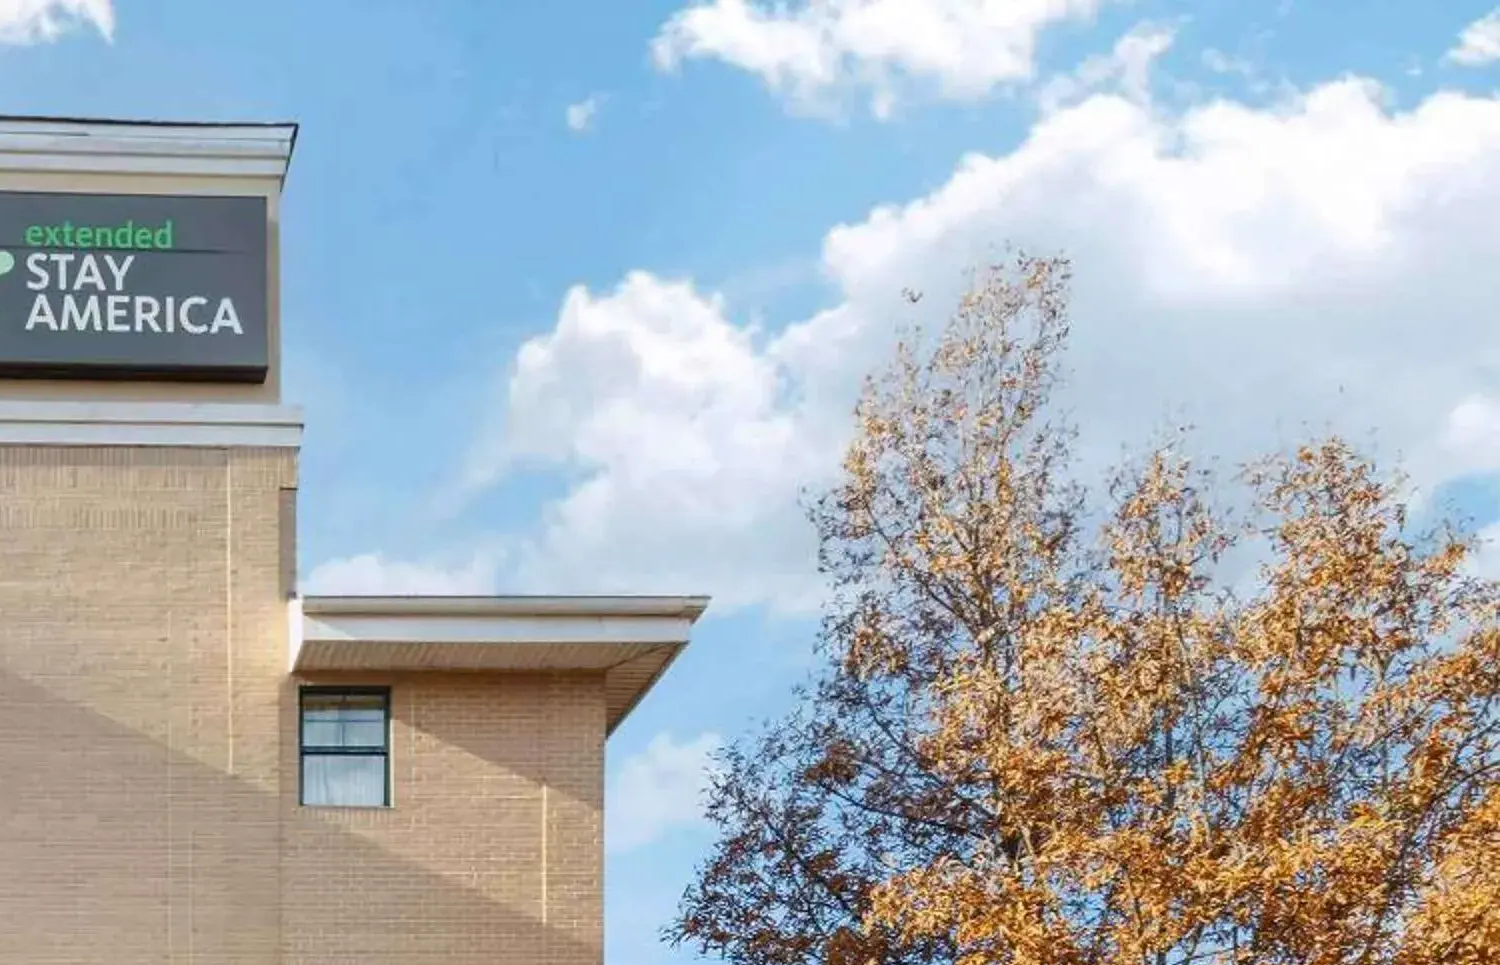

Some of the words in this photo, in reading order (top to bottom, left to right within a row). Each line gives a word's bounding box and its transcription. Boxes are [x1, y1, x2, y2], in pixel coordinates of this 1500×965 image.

[25, 220, 173, 249] extended
[26, 252, 135, 291] STAY
[24, 294, 244, 335] AMERICA
